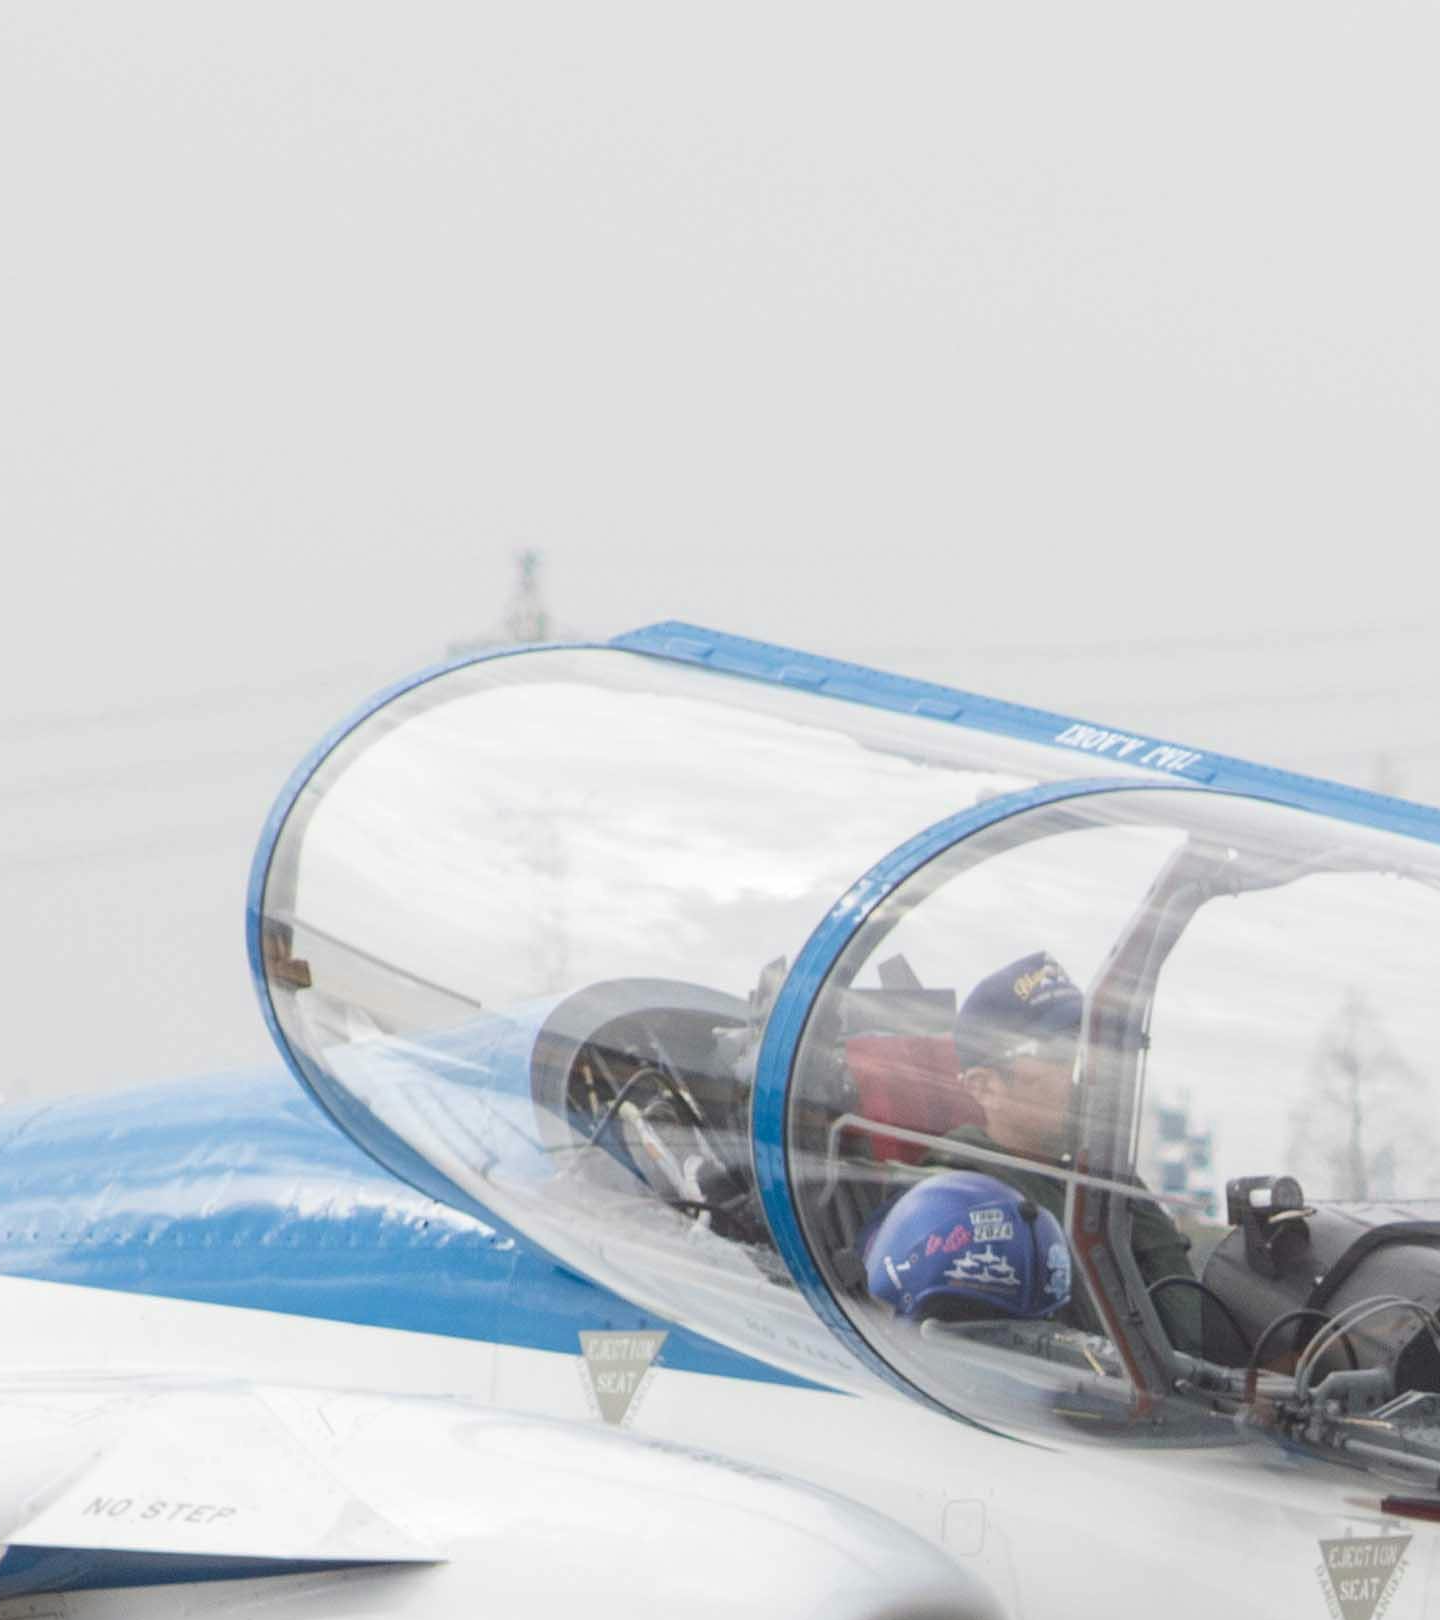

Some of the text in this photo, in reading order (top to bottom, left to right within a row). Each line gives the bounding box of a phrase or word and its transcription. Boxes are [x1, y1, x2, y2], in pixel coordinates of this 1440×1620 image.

[585, 1338, 656, 1361] EJECTION
[596, 1371, 637, 1393] SEAT
[82, 1496, 238, 1526] NO STEP
[1326, 1543, 1401, 1568] EJECTION
[1338, 1577, 1382, 1601] SEAT
